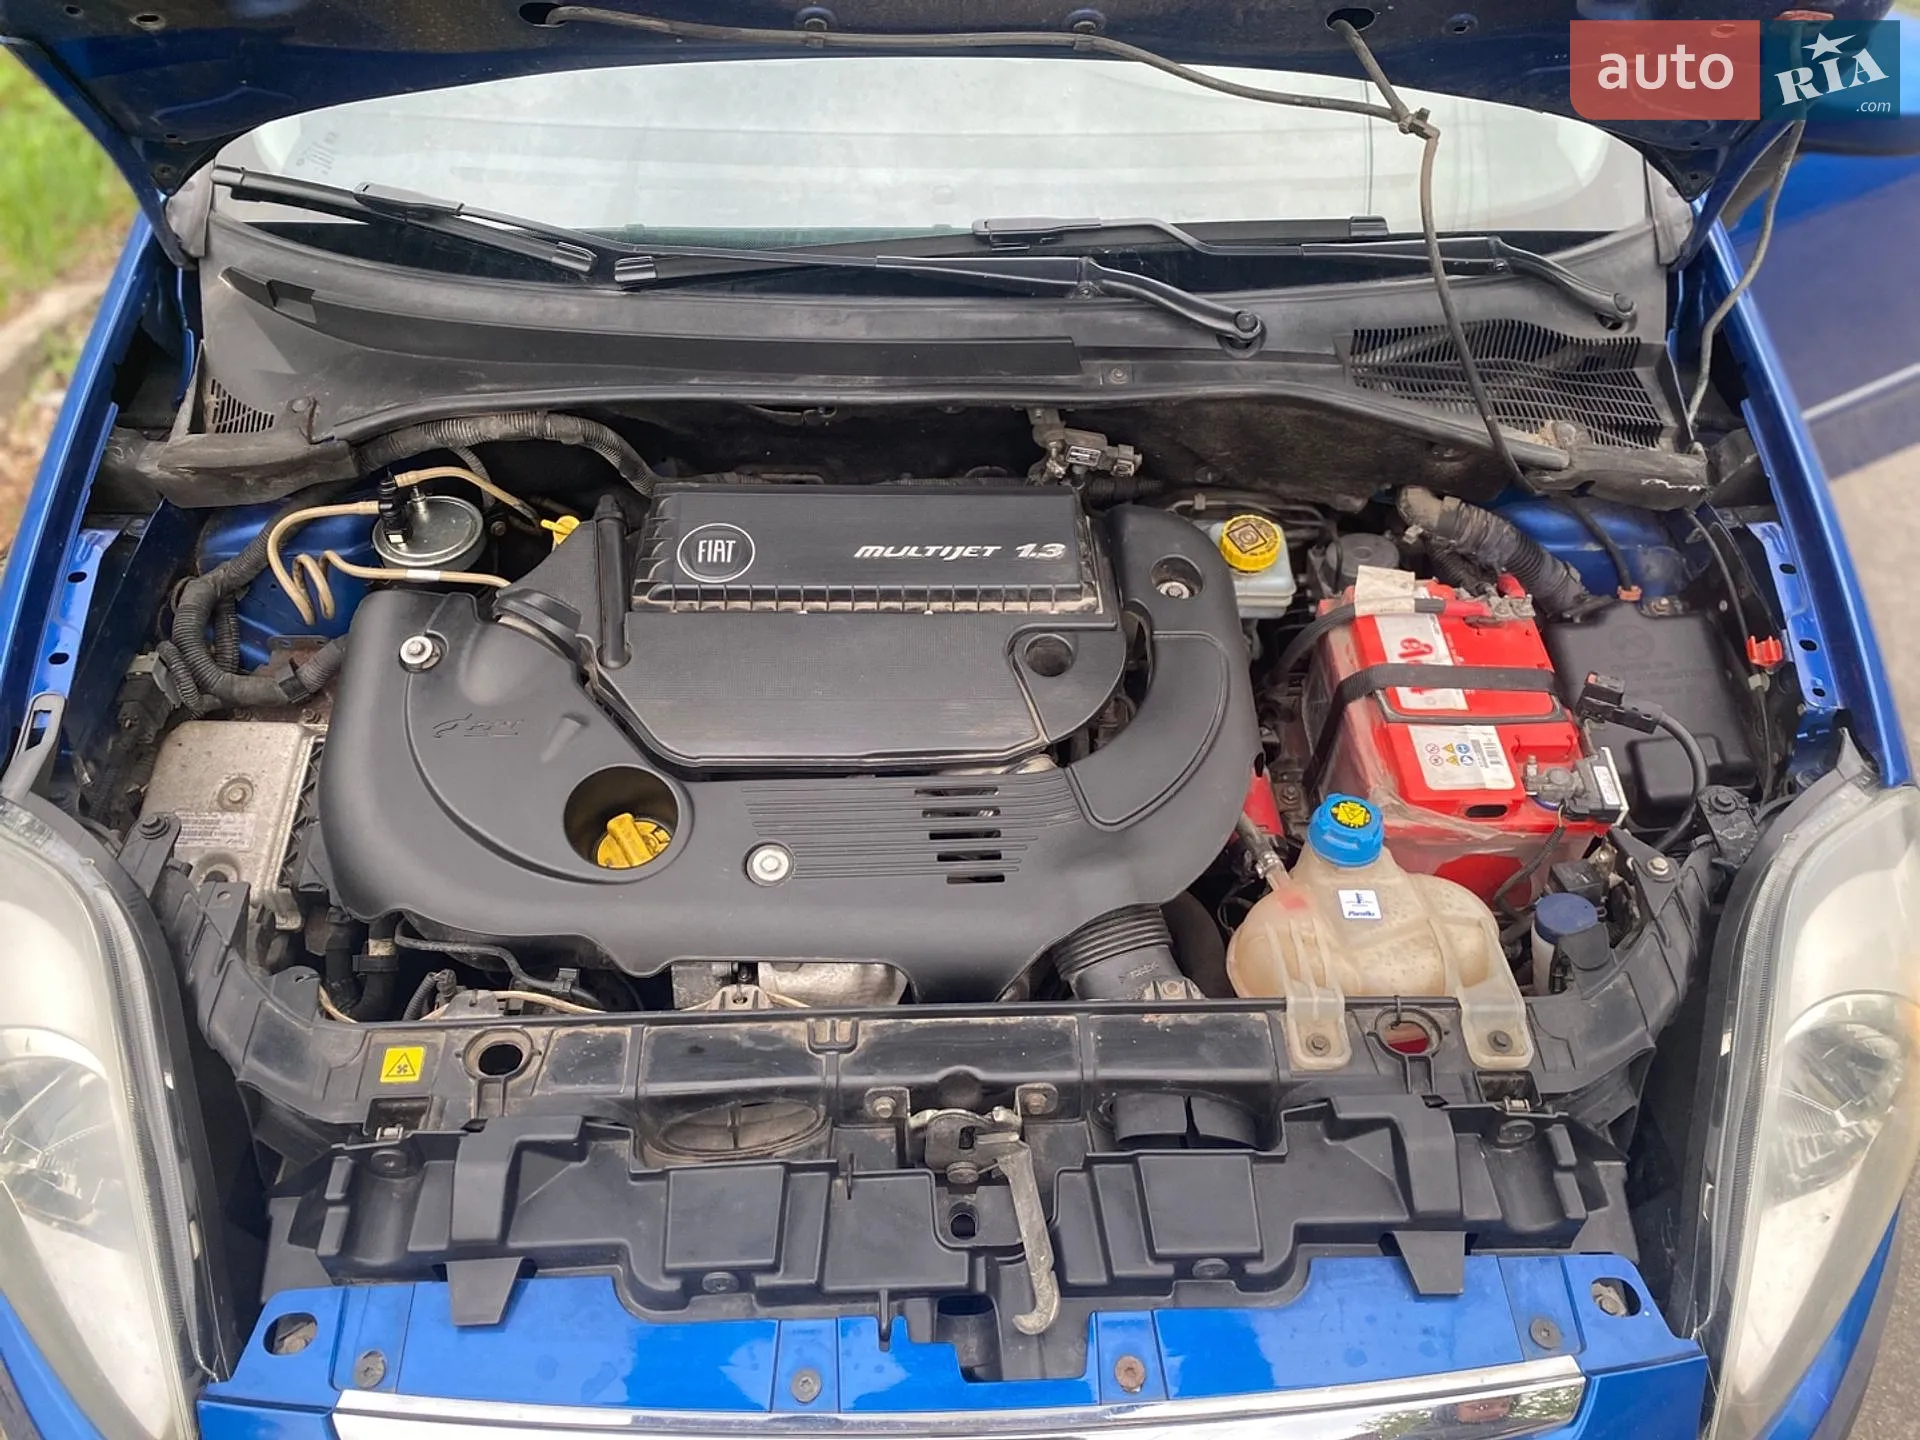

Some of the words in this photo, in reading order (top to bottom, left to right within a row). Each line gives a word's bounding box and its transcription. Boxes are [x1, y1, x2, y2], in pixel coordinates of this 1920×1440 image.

[698, 540, 737, 563] FIAT
[854, 545, 1002, 561] MULTIJET
[1015, 543, 1066, 558] 1.3
